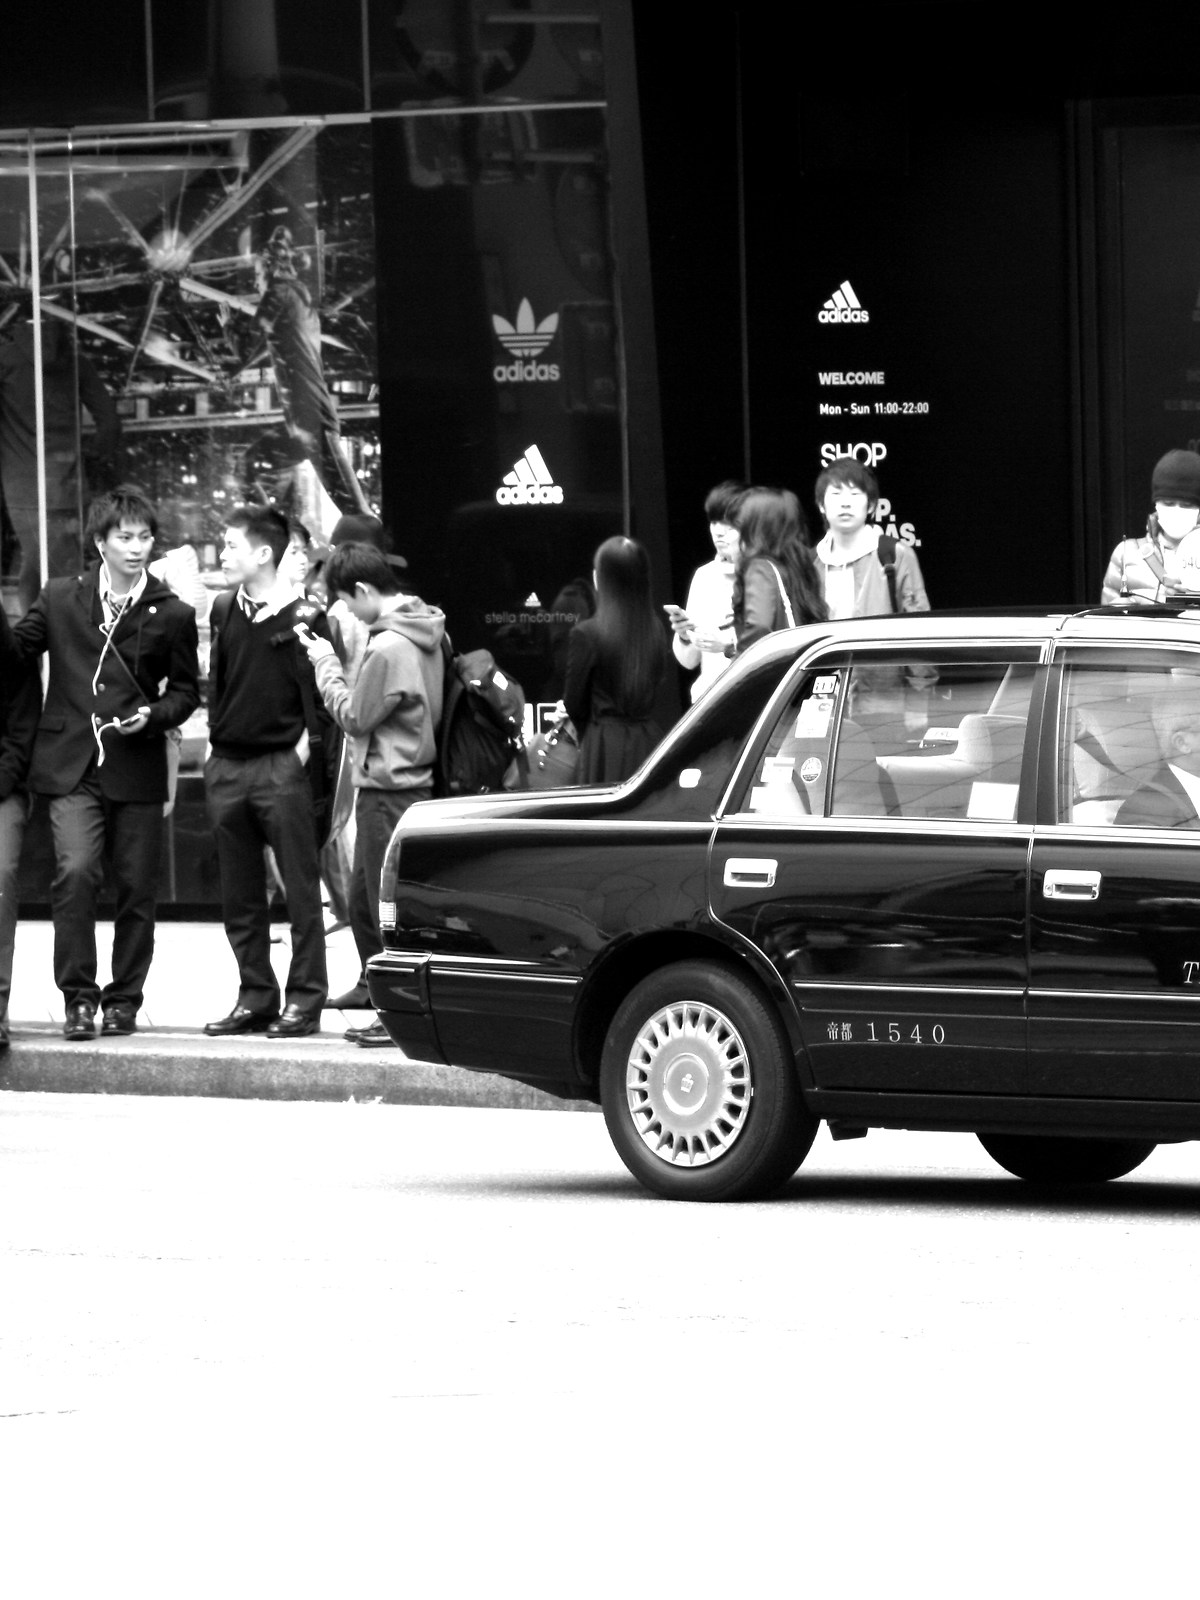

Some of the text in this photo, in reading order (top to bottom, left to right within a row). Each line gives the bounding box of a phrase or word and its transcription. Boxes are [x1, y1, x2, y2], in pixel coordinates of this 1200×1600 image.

[818, 307, 869, 323] adidas
[493, 361, 561, 382] adidas
[818, 371, 885, 385] WELCOME
[819, 403, 842, 415] Mon
[850, 402, 870, 414] Sun
[874, 401, 930, 414] 11:00-22:00
[820, 442, 887, 468] SHOP
[496, 483, 564, 505] adidas
[827, 1021, 946, 1045] 帝都 1540
